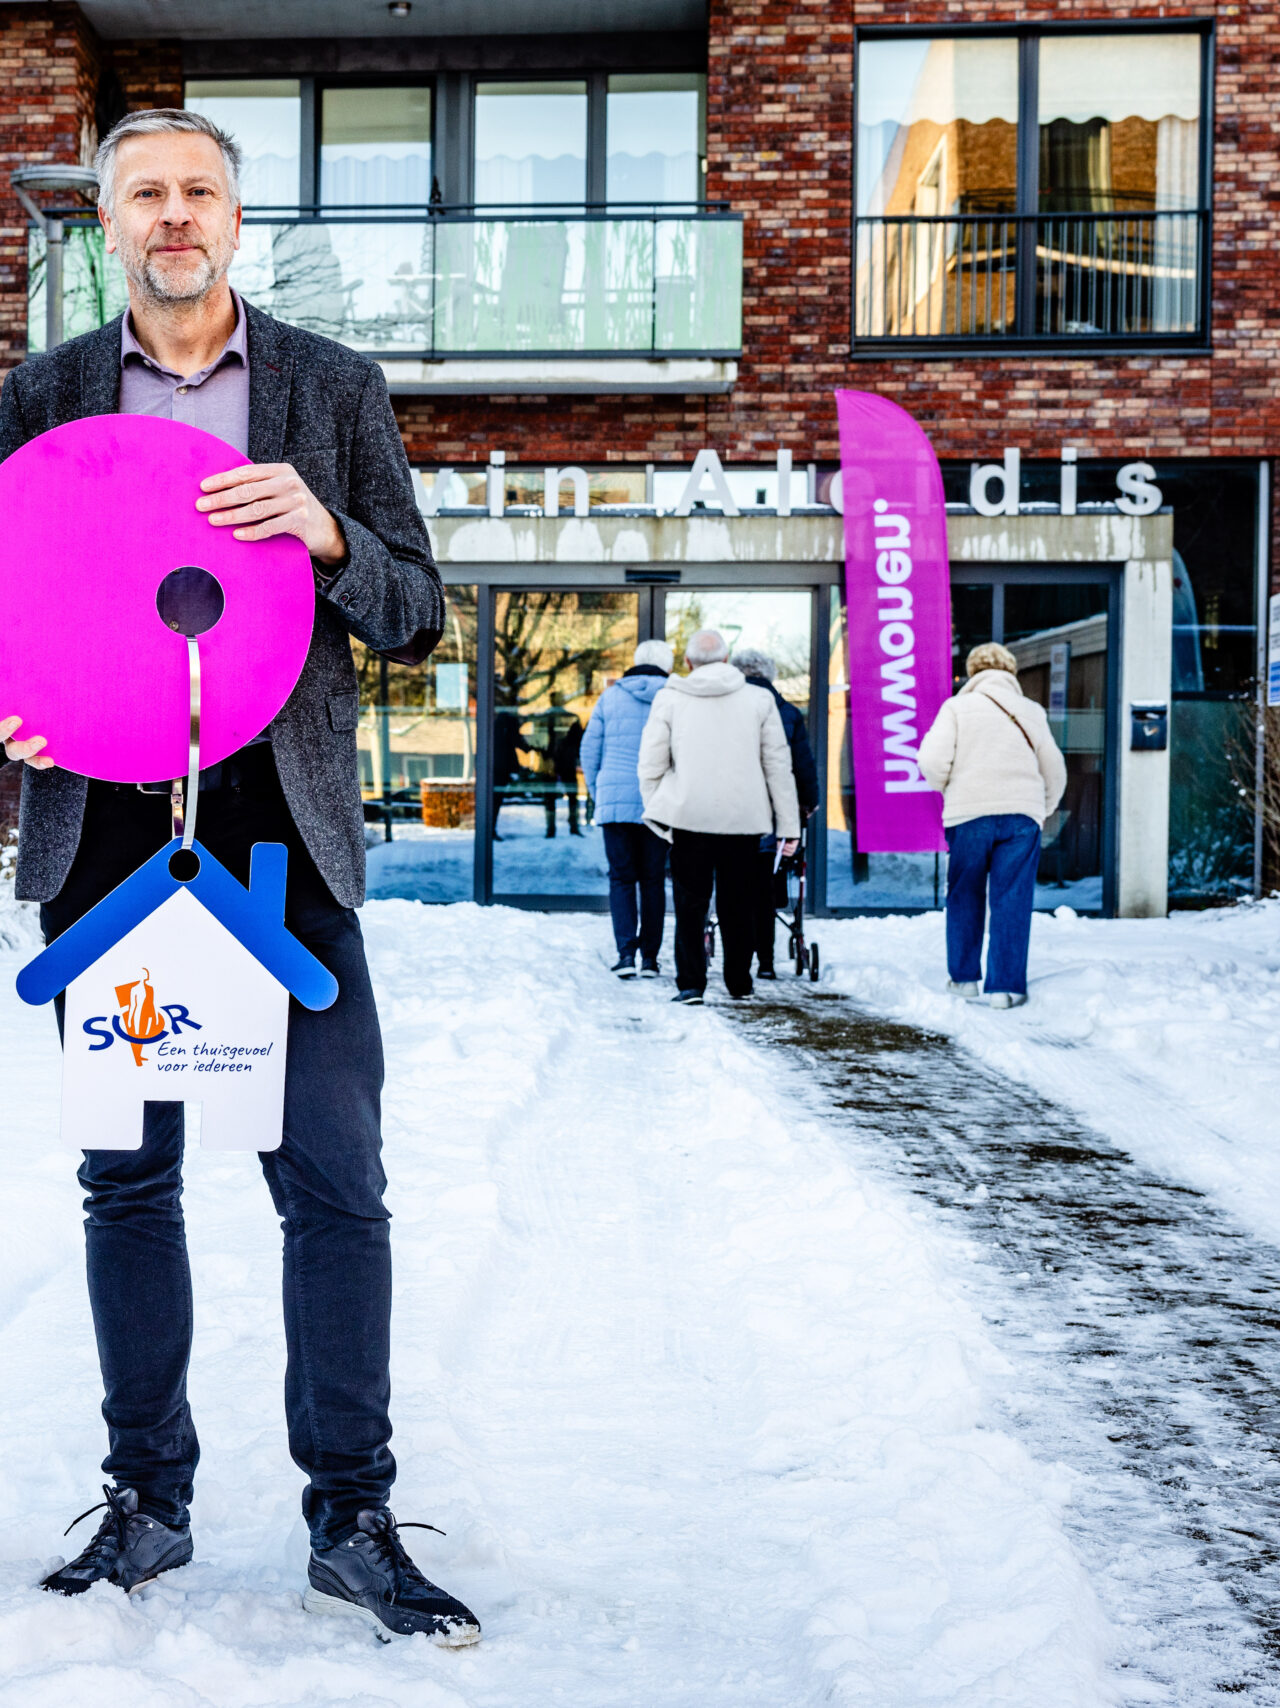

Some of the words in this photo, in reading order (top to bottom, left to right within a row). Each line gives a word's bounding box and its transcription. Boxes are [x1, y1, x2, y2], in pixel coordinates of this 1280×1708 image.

[872, 497, 934, 794] hwwonen.
[157, 1041, 186, 1057] Een
[193, 1042, 274, 1060] thuisgevoel
[157, 1063, 188, 1072] voor
[193, 1058, 252, 1073] iedereen
